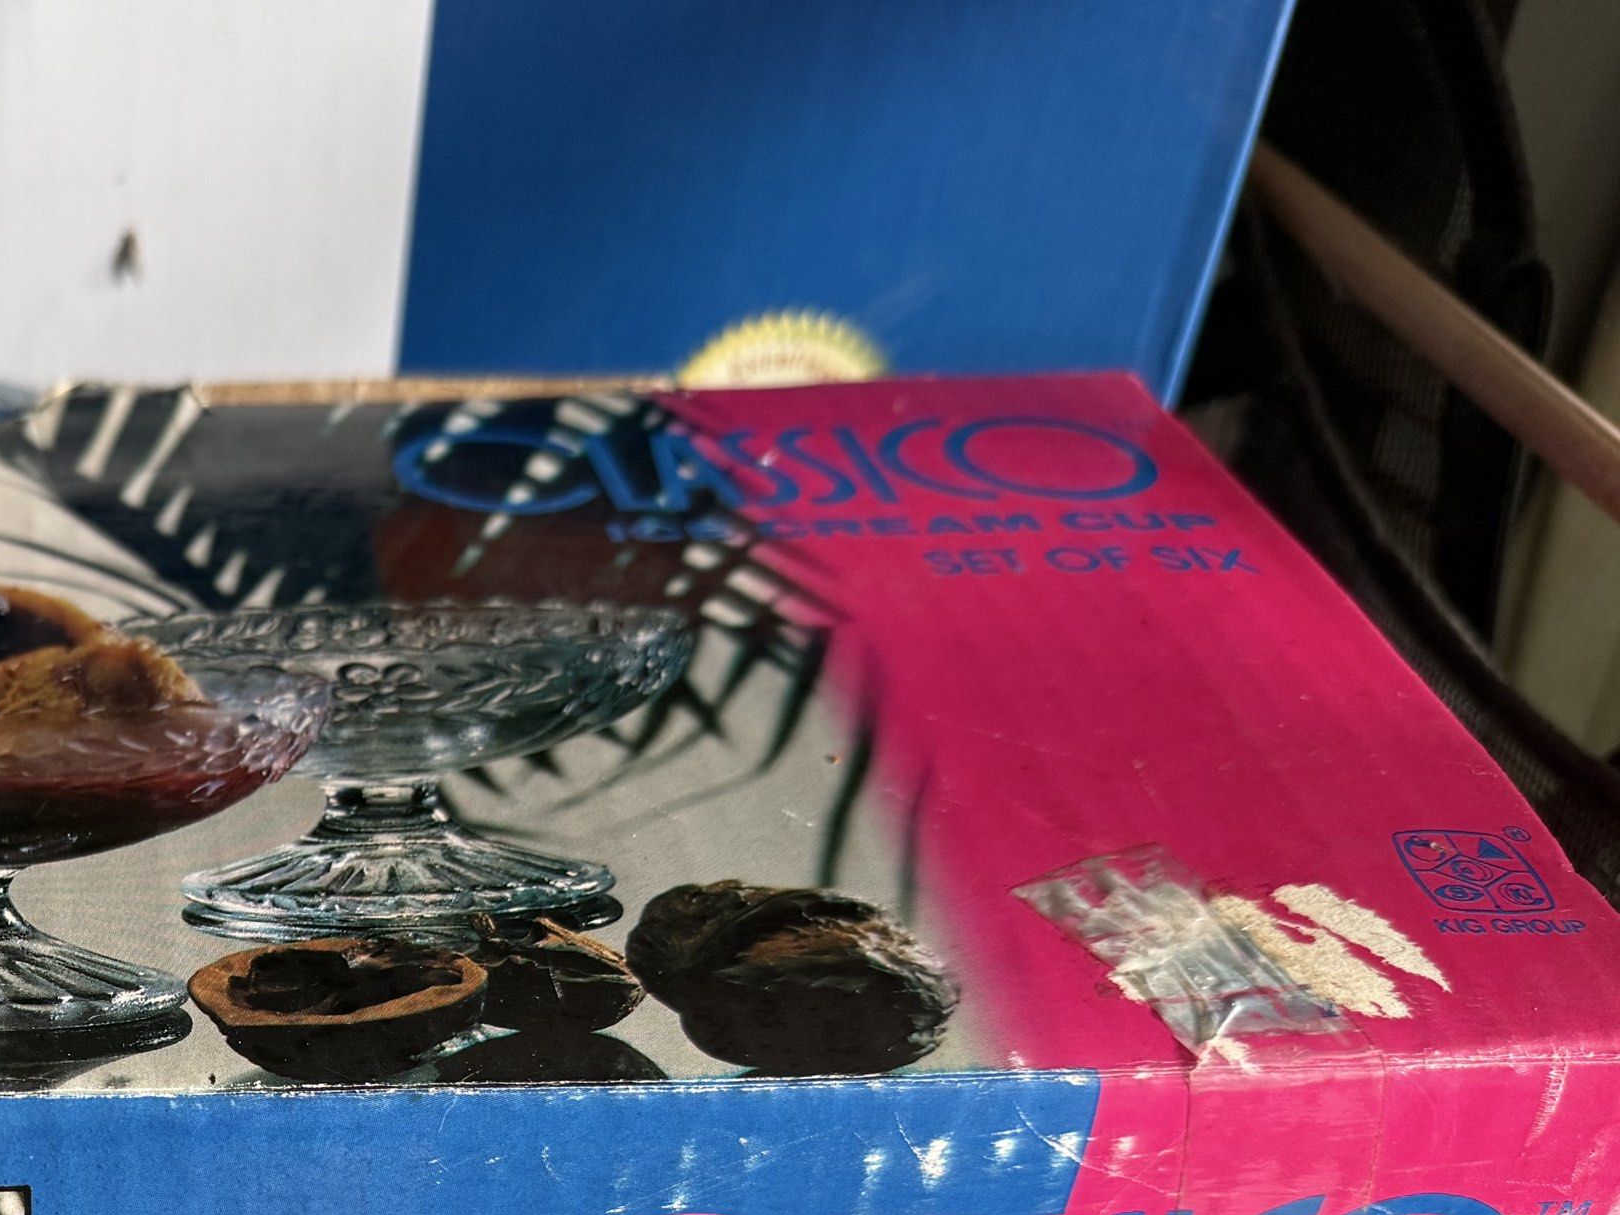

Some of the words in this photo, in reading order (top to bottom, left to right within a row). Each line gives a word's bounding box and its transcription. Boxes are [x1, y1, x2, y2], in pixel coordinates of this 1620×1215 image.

[392, 414, 1159, 515] CLASSICO
[756, 511, 1044, 540] CREAM
[1059, 509, 1219, 534] CUP
[924, 546, 1026, 579] SET
[1033, 544, 1132, 575] OF
[1150, 543, 1261, 577] SIX
[1491, 918, 1586, 936] GROUP
